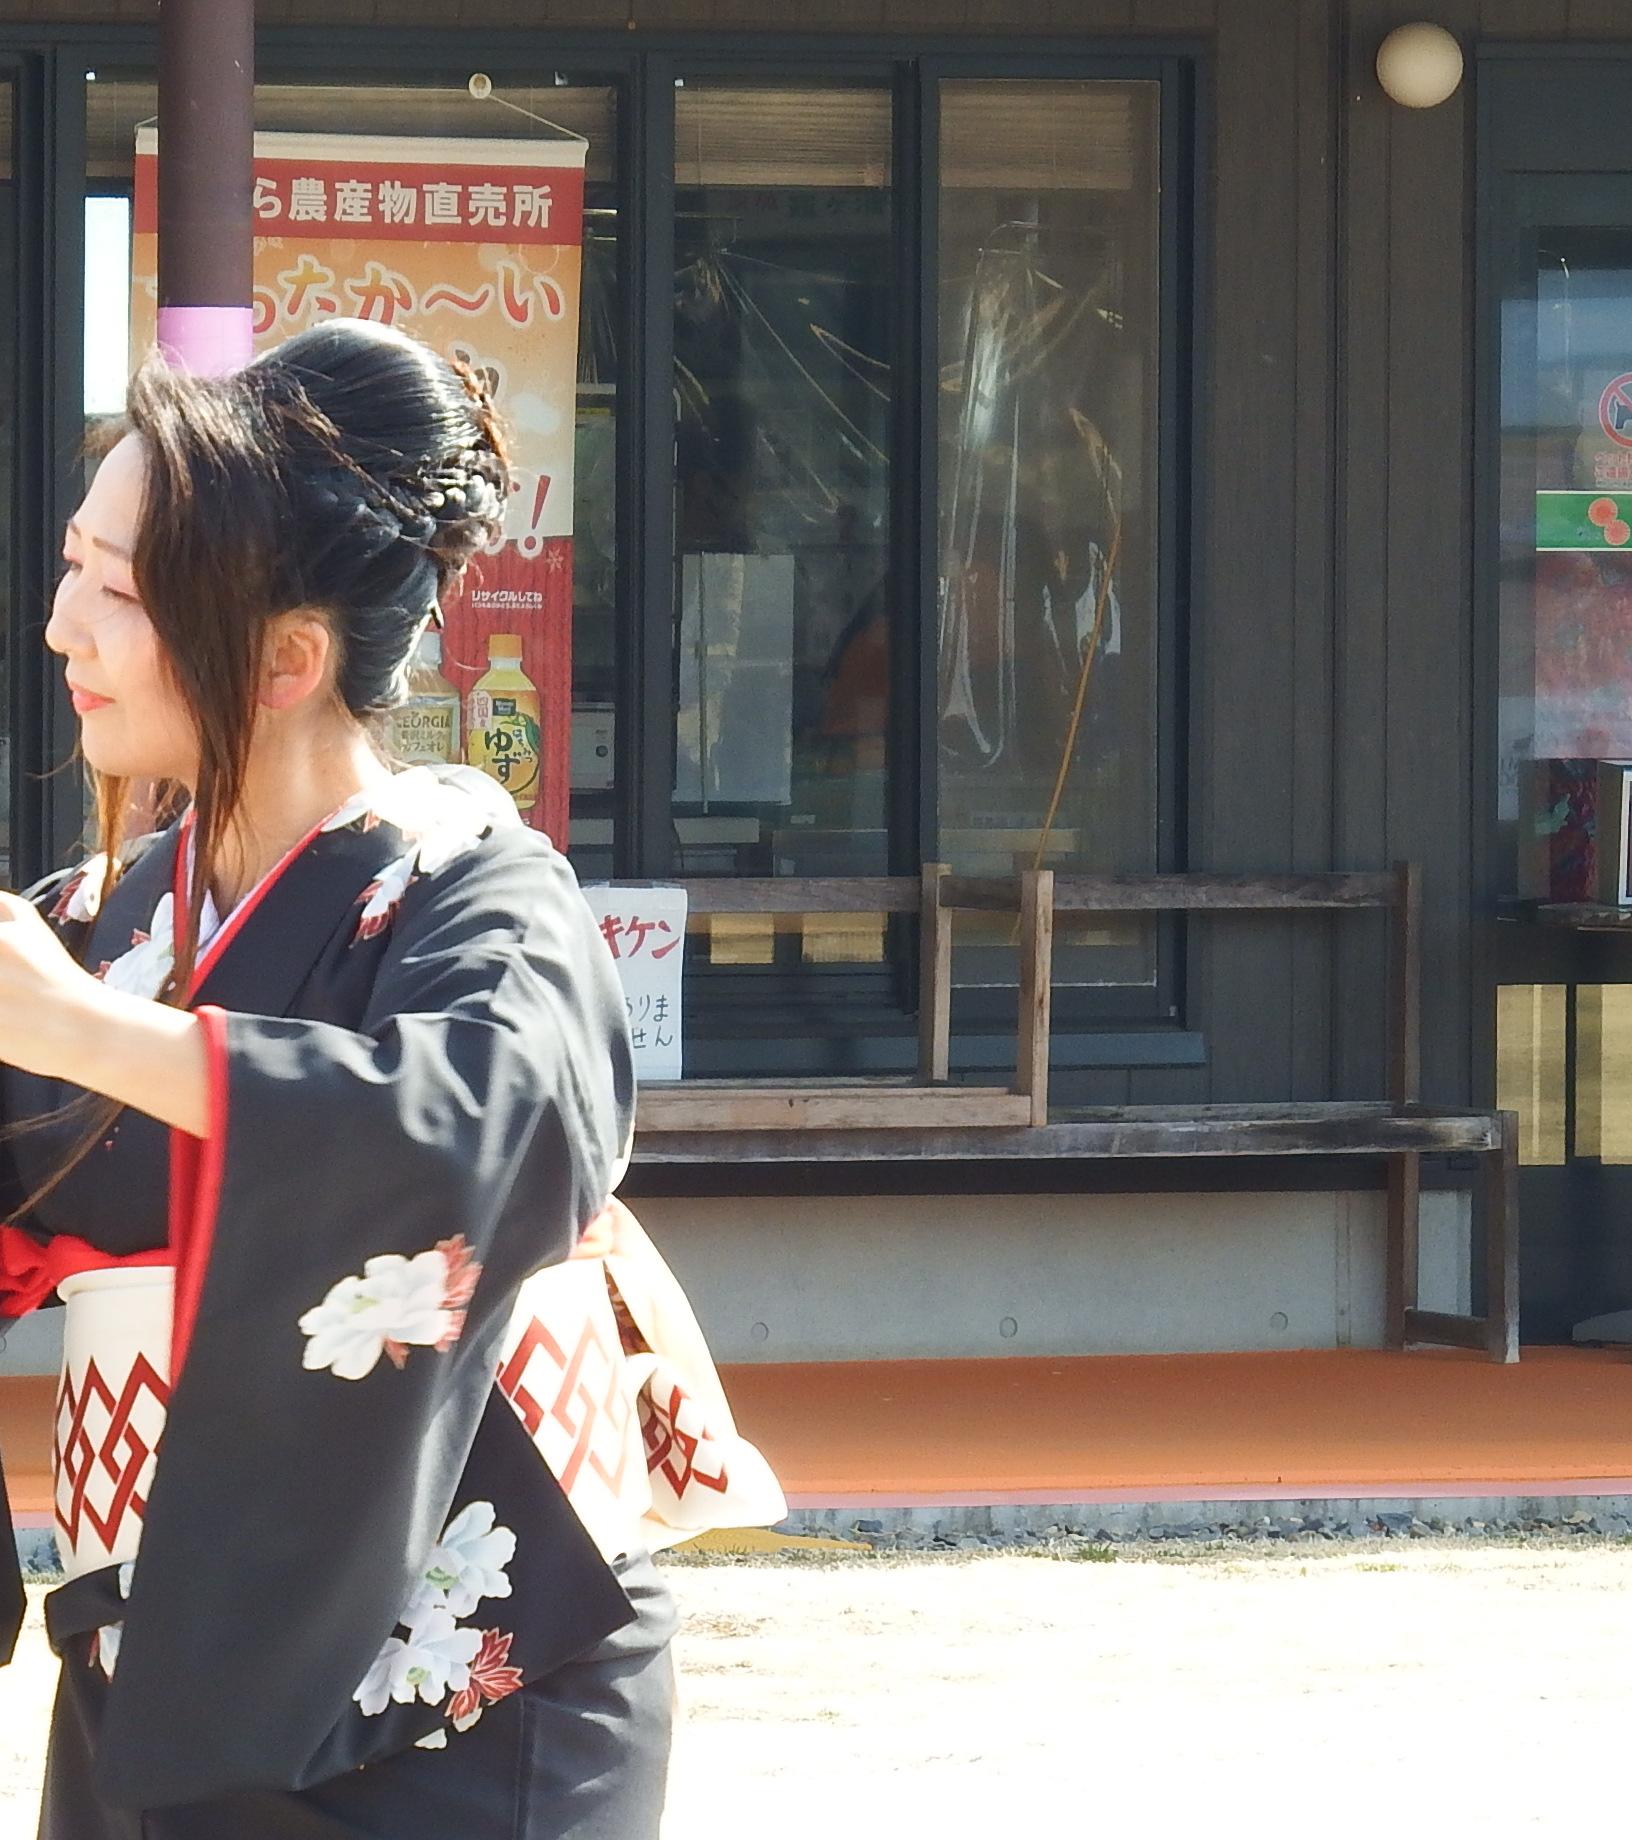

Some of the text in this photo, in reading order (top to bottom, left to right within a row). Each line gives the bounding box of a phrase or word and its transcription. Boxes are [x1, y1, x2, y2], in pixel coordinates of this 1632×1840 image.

[254, 177, 552, 228] ら農産物直売所
[472, 590, 543, 602] リサイクルしてね
[599, 914, 681, 960] キケン
